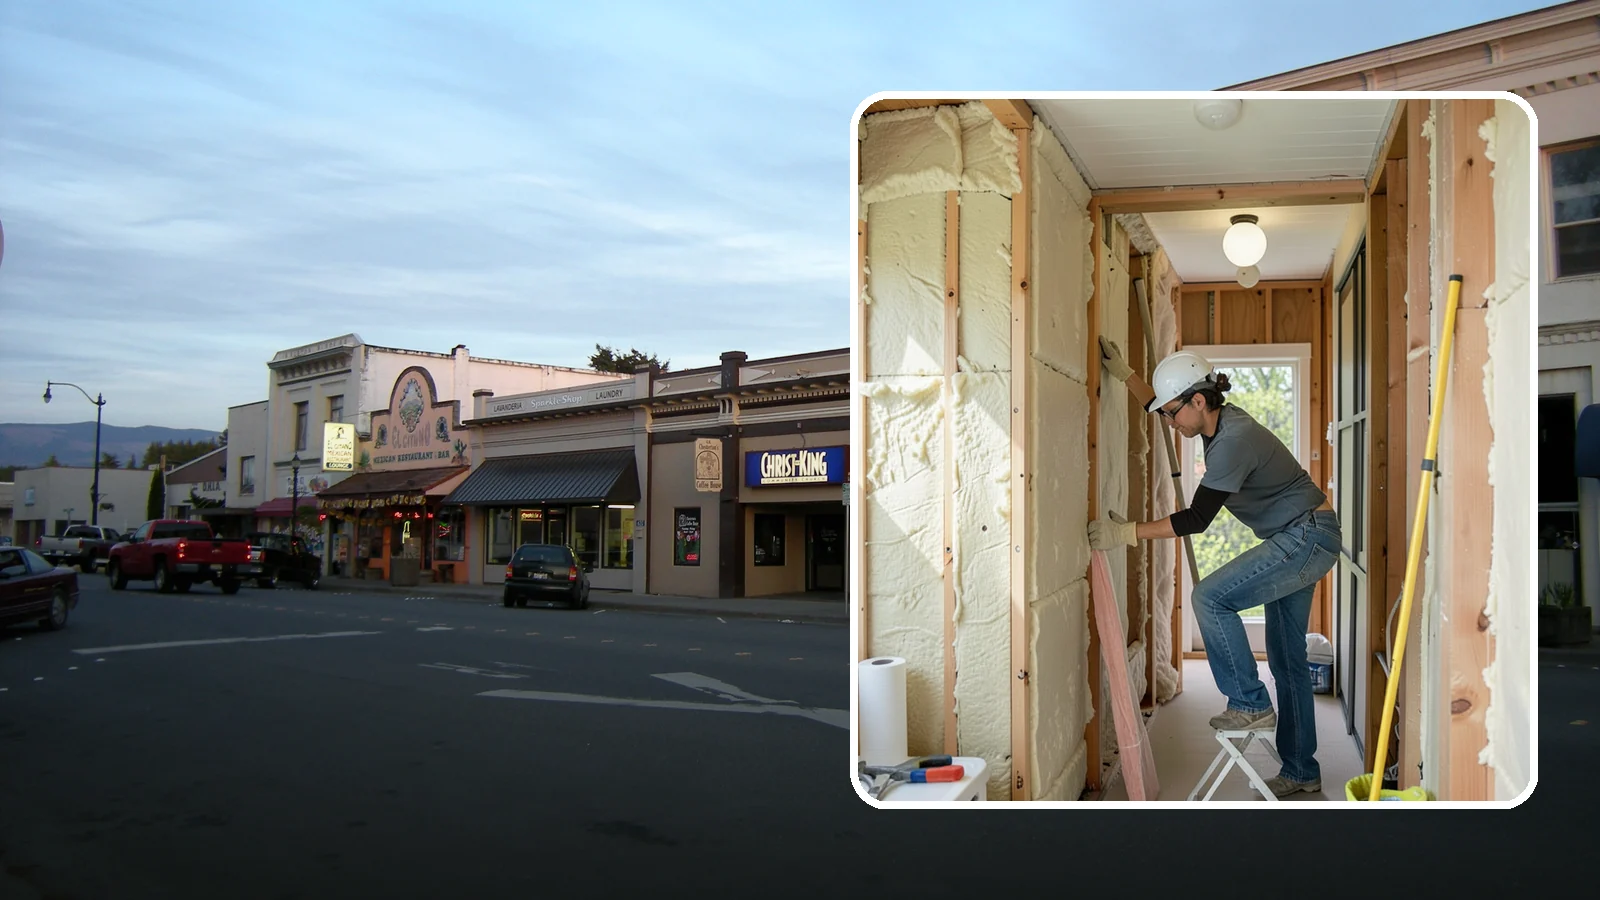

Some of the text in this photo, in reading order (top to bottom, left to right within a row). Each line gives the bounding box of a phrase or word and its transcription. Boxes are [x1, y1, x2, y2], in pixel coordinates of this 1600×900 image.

[531, 394, 582, 409] Sparkle Shop
[595, 389, 623, 400] LAUNDRY
[493, 402, 522, 412] LAVANDERIA
[373, 454, 396, 464] MEXICAN
[397, 451, 433, 463] RESTAURANT
[438, 450, 450, 459] BAR
[761, 450, 827, 478] CHRIST KING
